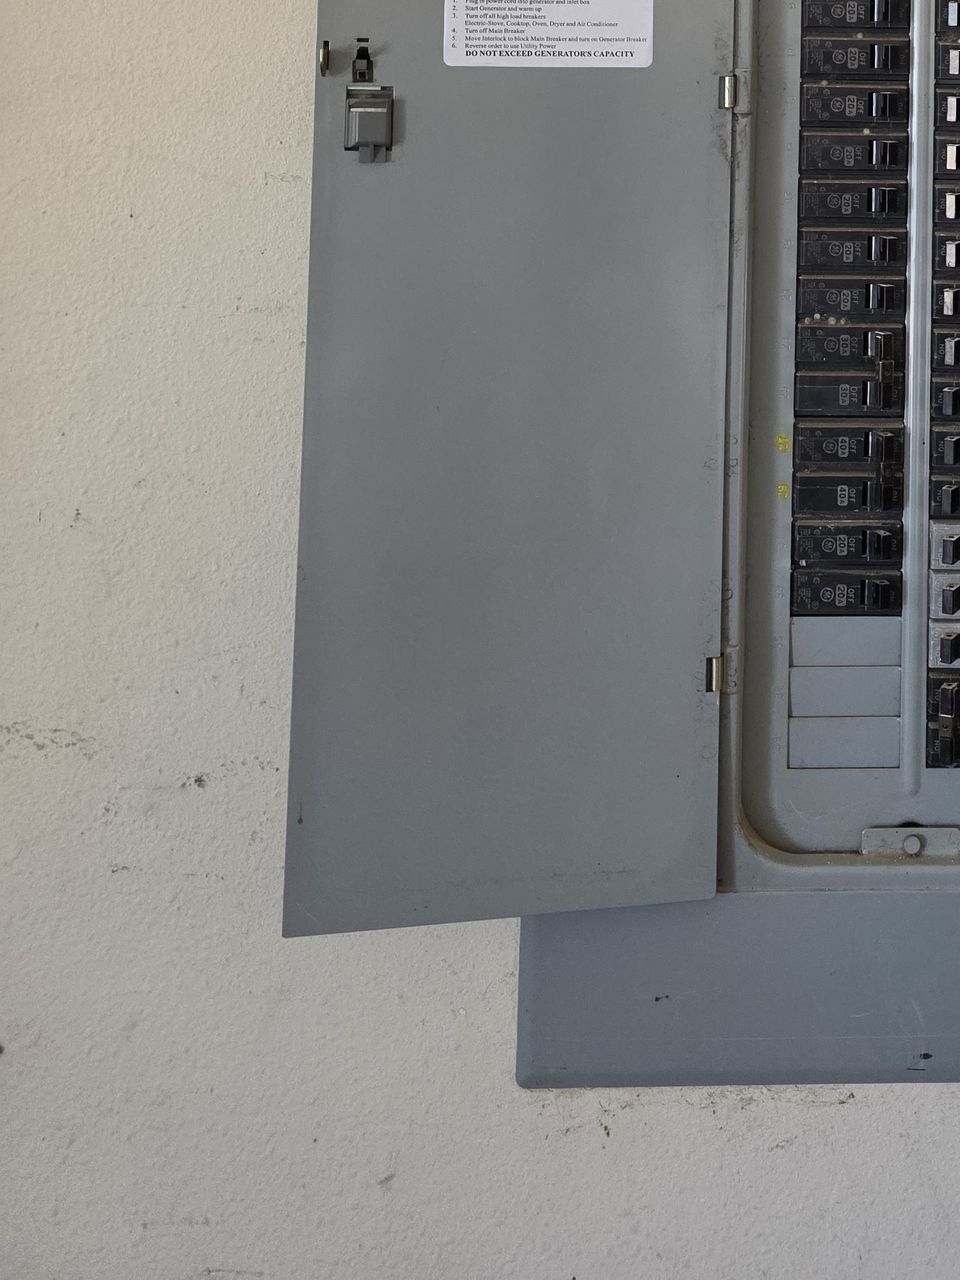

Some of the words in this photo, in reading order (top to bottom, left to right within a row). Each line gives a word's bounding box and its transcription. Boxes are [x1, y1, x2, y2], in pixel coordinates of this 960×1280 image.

[593, 50, 635, 58] CAPACITY
[840, 334, 850, 356] 30A
[839, 384, 850, 405] 30A
[838, 436, 848, 458] 40A
[838, 485, 848, 506] 40A
[837, 535, 848, 556] 20A
[836, 585, 847, 606] 20A
